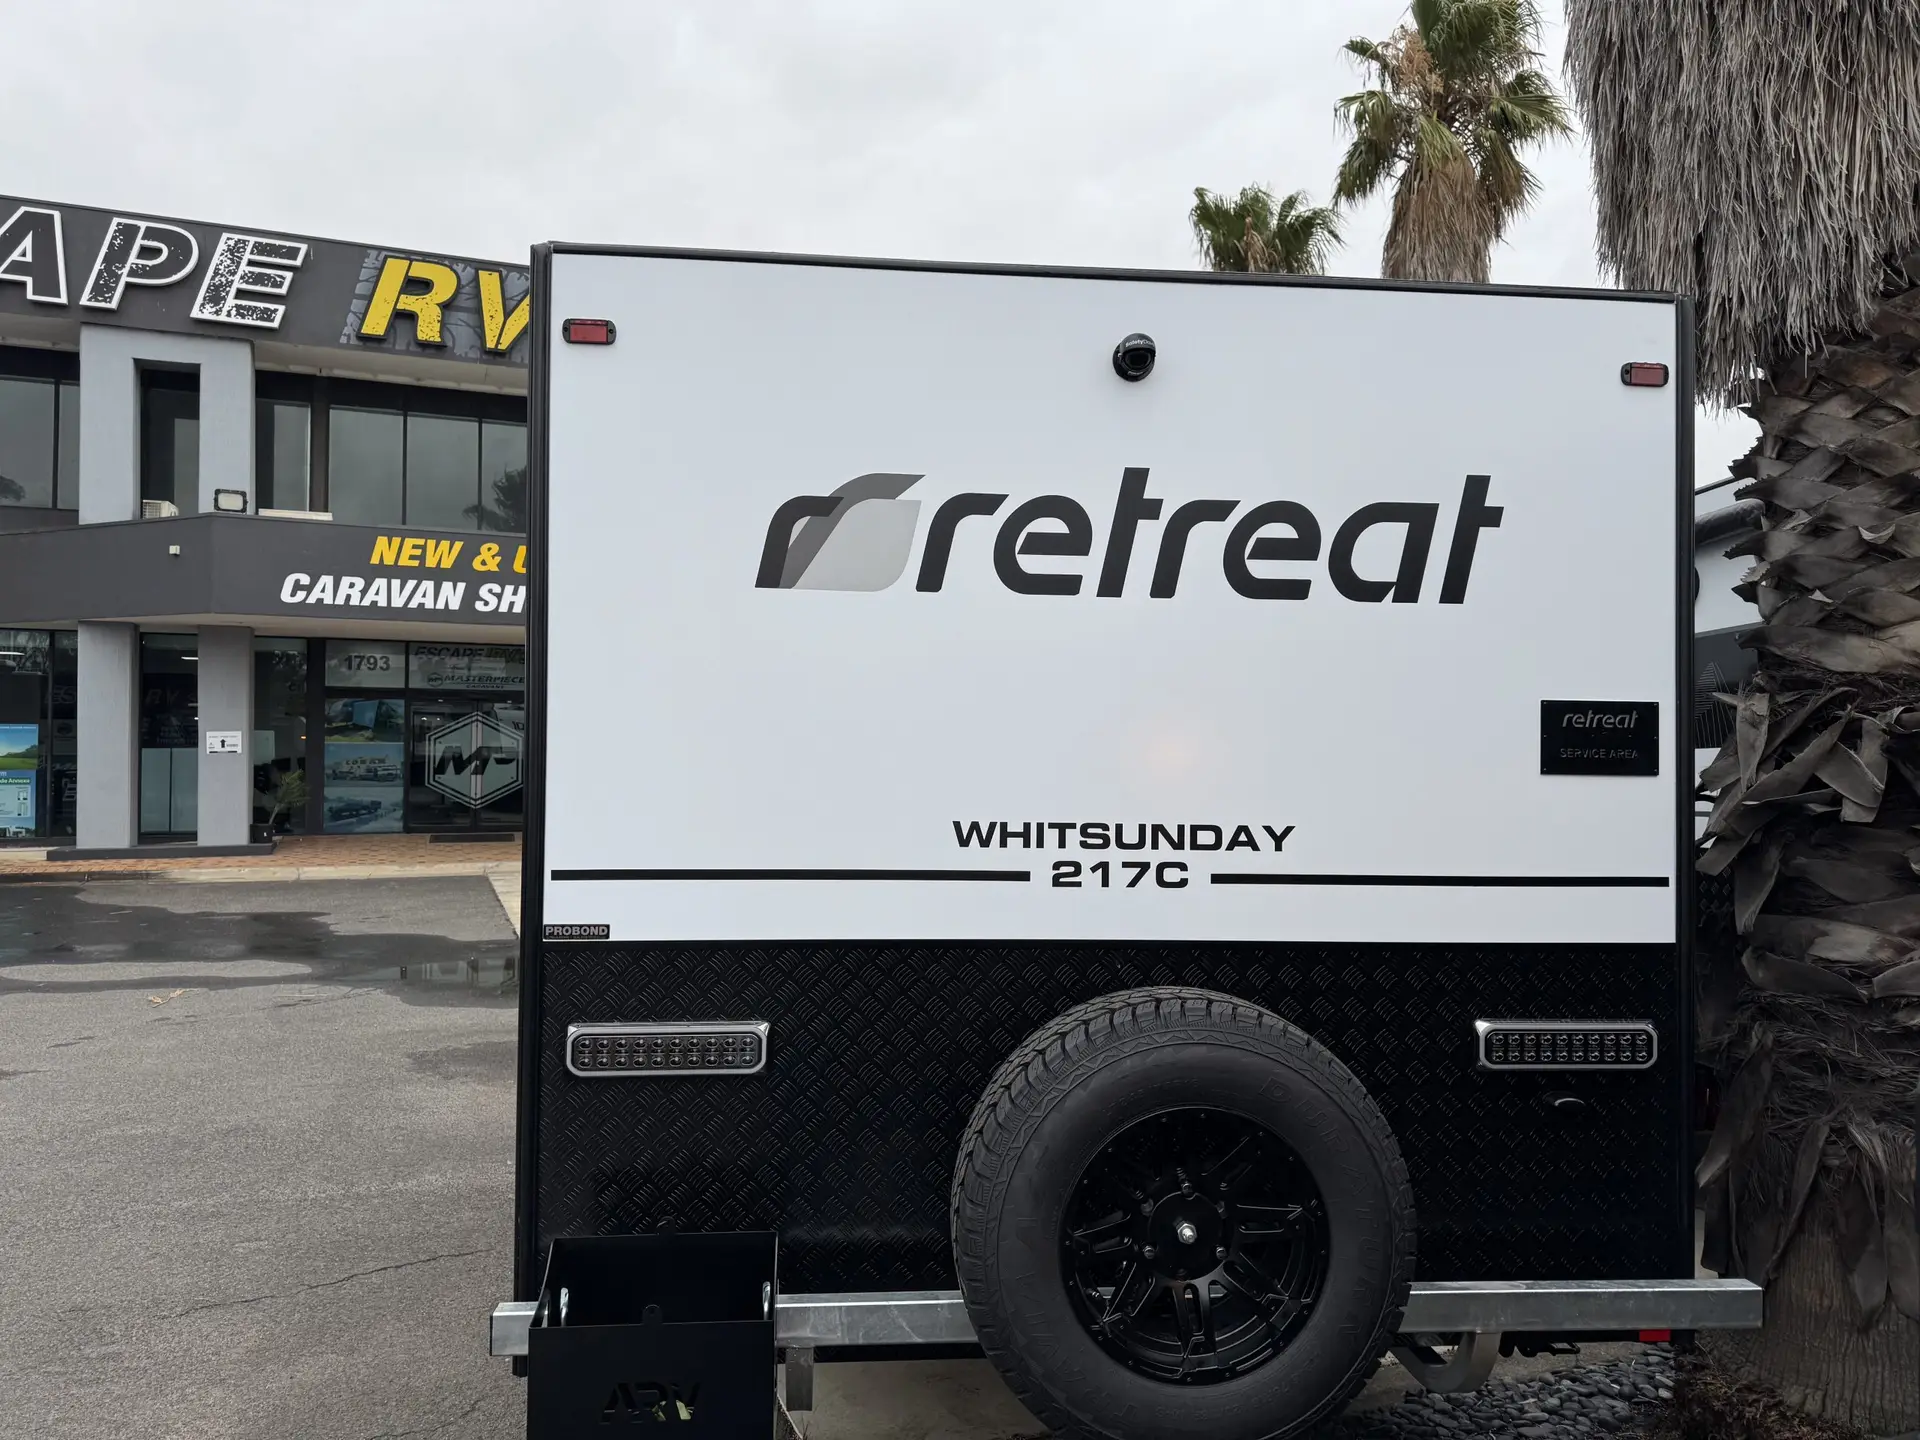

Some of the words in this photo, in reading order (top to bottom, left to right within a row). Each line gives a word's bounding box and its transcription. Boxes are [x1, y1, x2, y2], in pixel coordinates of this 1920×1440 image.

[916, 467, 1504, 605] retreat
[370, 535, 465, 569] NEW
[472, 542, 502, 572] &
[280, 572, 467, 611] CARAVAN
[343, 655, 391, 672] 1793
[1562, 709, 1639, 729] retreat
[1560, 748, 1606, 759] SERVICE
[1609, 749, 1639, 759] AREA
[952, 820, 1296, 852] WHITSUNDAY
[1051, 860, 1189, 889] 217C
[545, 926, 608, 936] PROBOND
